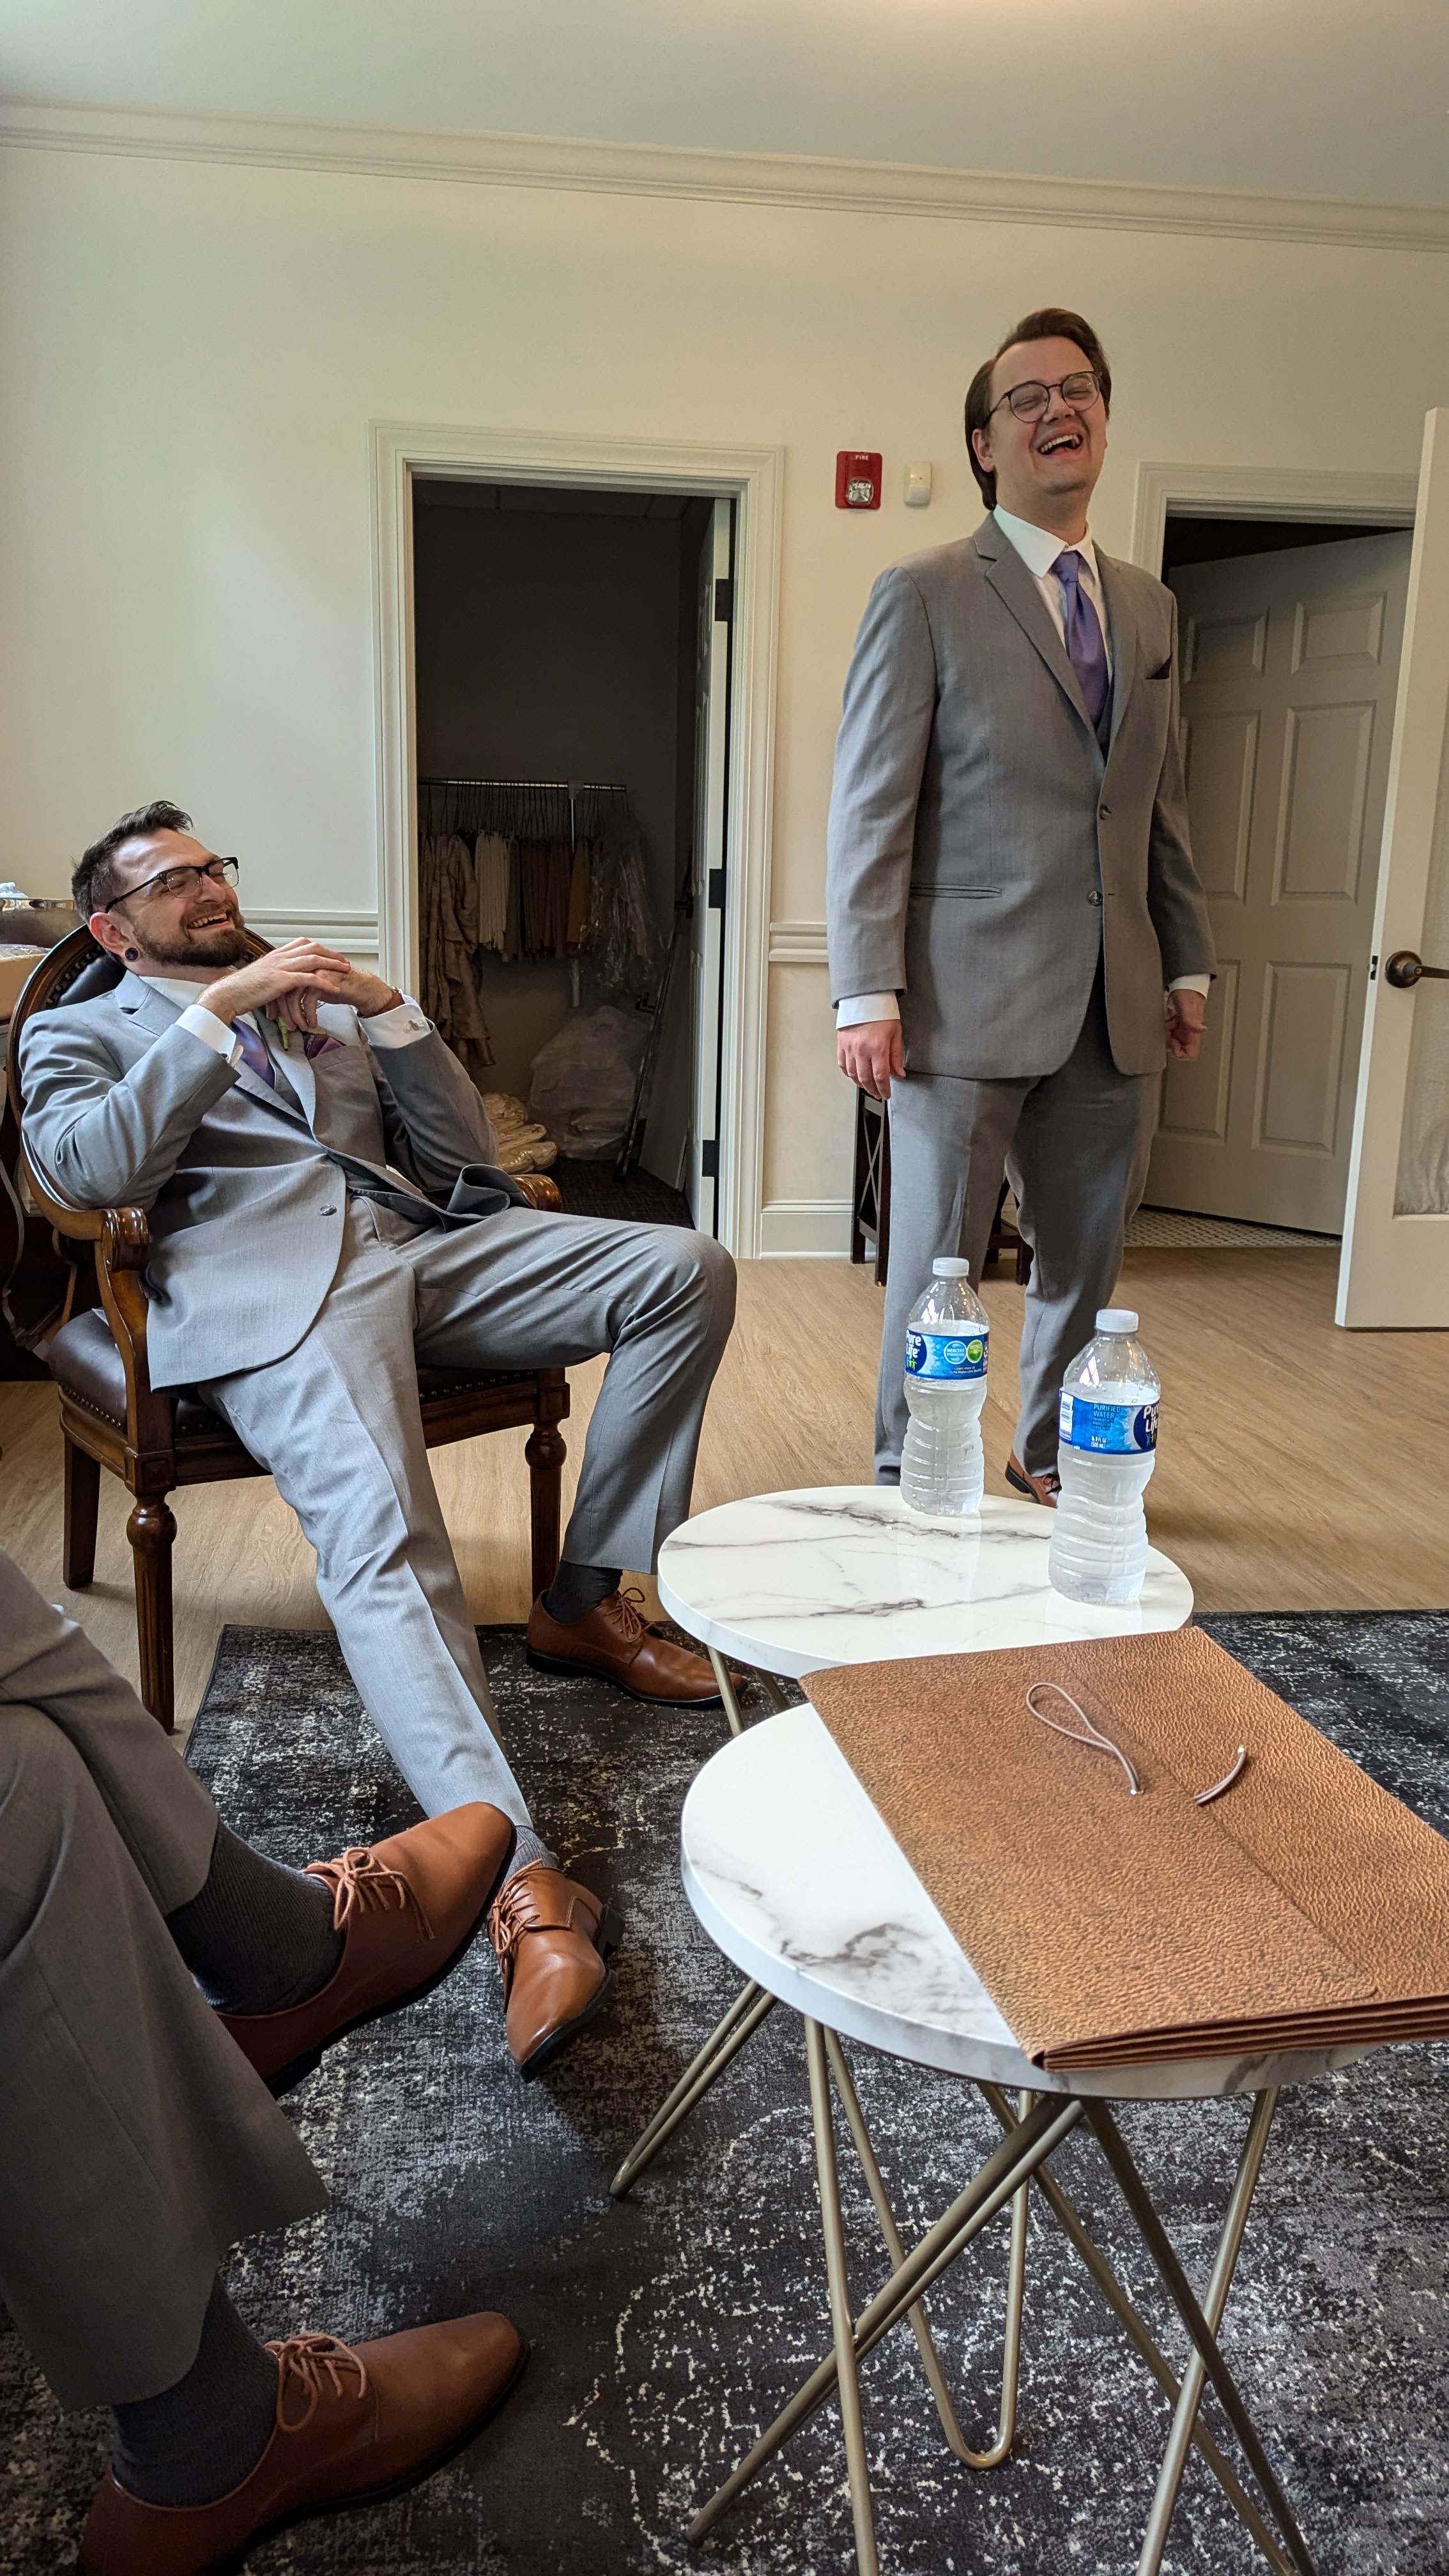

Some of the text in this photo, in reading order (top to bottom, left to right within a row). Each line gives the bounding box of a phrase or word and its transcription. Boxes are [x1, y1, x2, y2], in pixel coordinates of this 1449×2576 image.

[906, 1330, 921, 1346] Pure
[906, 1343, 918, 1359] Life
[1093, 1404, 1121, 1413] PURIFIED
